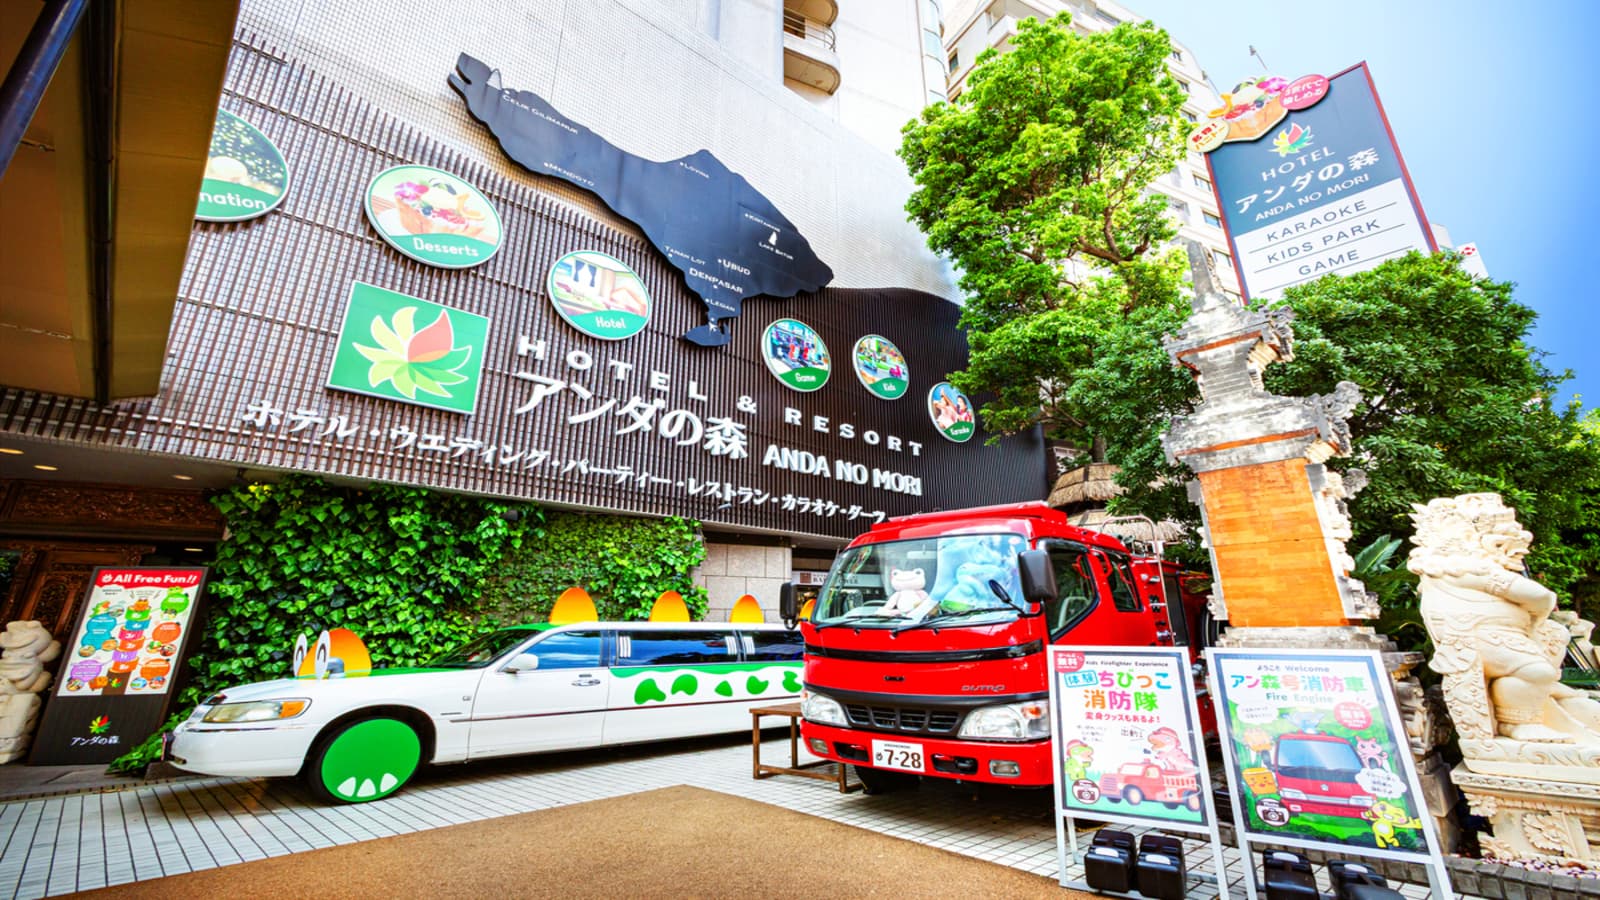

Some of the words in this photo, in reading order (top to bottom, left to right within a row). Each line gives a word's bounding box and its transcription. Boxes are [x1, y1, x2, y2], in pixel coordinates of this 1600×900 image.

[1262, 146, 1336, 182] HOTEL
[1235, 147, 1380, 214] アンダの森
[1255, 202, 1295, 221] ANDA
[1298, 191, 1322, 206] NO
[1327, 173, 1370, 195] MORI
[1267, 200, 1367, 243] KARAOKE
[412, 237, 479, 258] Desserts
[1267, 242, 1314, 264] KIDS
[1322, 219, 1381, 246] PARK
[722, 259, 751, 276] UBUD
[1298, 250, 1360, 276] GAME
[689, 267, 744, 294] DENPASAR
[595, 315, 627, 329] Hotel
[517, 335, 707, 402] HOTEL
[737, 395, 757, 414] &
[785, 406, 922, 456] RESORT
[514, 370, 748, 460] アンダの森
[763, 444, 831, 478] ANDA
[835, 460, 868, 485] NO
[872, 468, 922, 496] MORI
[113, 573, 132, 583] All
[135, 573, 162, 583] Free
[1098, 668, 1172, 690] ちびっこ
[1231, 674, 1368, 692] アン森号消防車
[1084, 689, 1159, 711] 消防隊
[1266, 692, 1288, 701] Fire
[1293, 693, 1334, 704] Engine
[884, 749, 922, 768] 7-28
